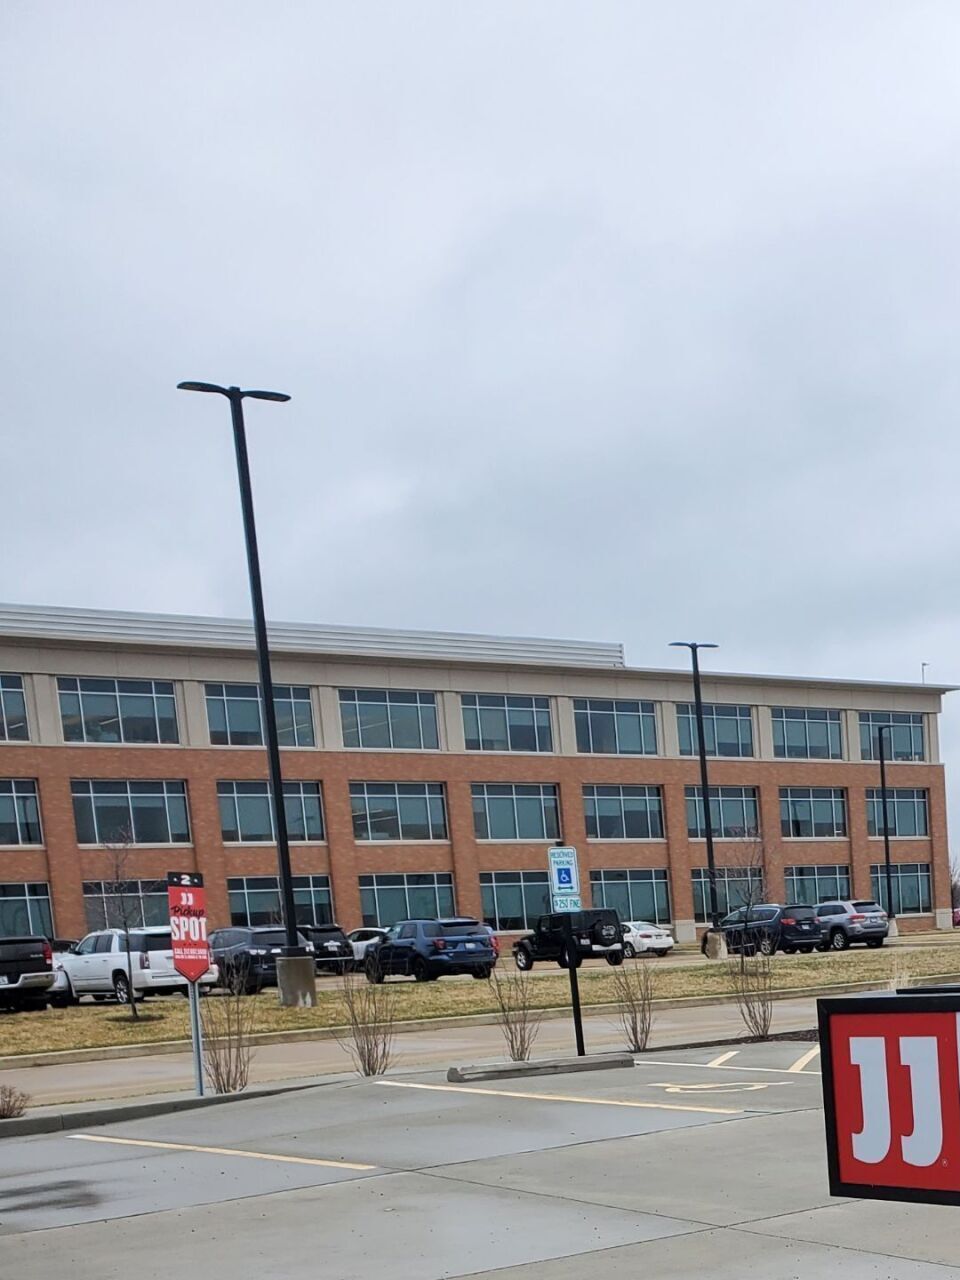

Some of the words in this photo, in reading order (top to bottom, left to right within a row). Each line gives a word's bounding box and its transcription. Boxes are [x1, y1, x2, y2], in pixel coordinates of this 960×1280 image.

[181, 875, 191, 885] 2
[171, 906, 204, 917] Pickup
[170, 916, 207, 941] SPOT
[849, 1036, 944, 1168] JJ
